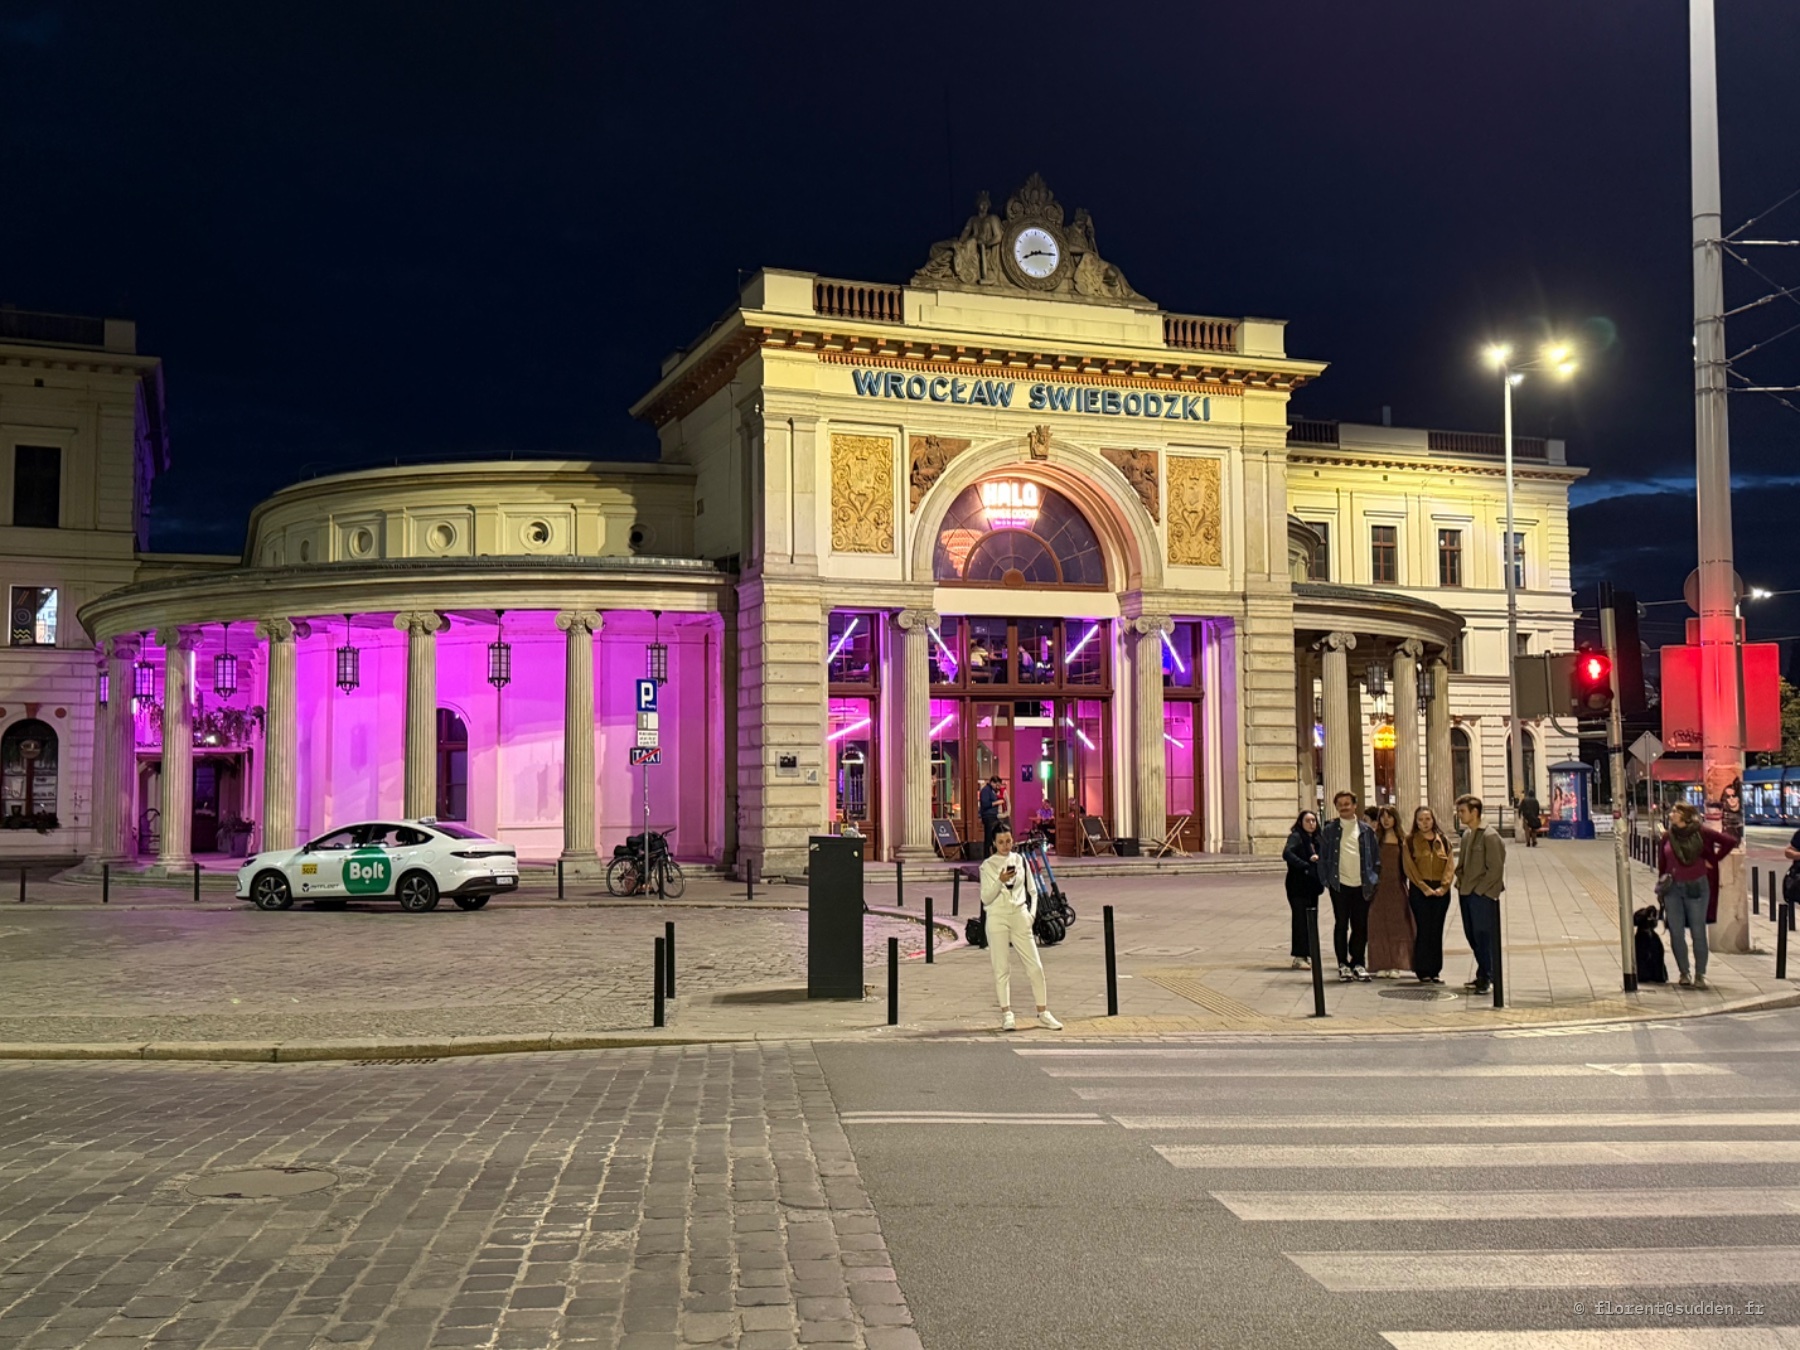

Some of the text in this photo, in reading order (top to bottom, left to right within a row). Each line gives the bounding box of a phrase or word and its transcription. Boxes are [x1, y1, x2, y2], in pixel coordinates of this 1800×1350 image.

[852, 368, 1015, 408] WROCŁAW
[640, 681, 654, 709] P
[634, 749, 660, 763] TAXI
[349, 861, 385, 884] Bolt
